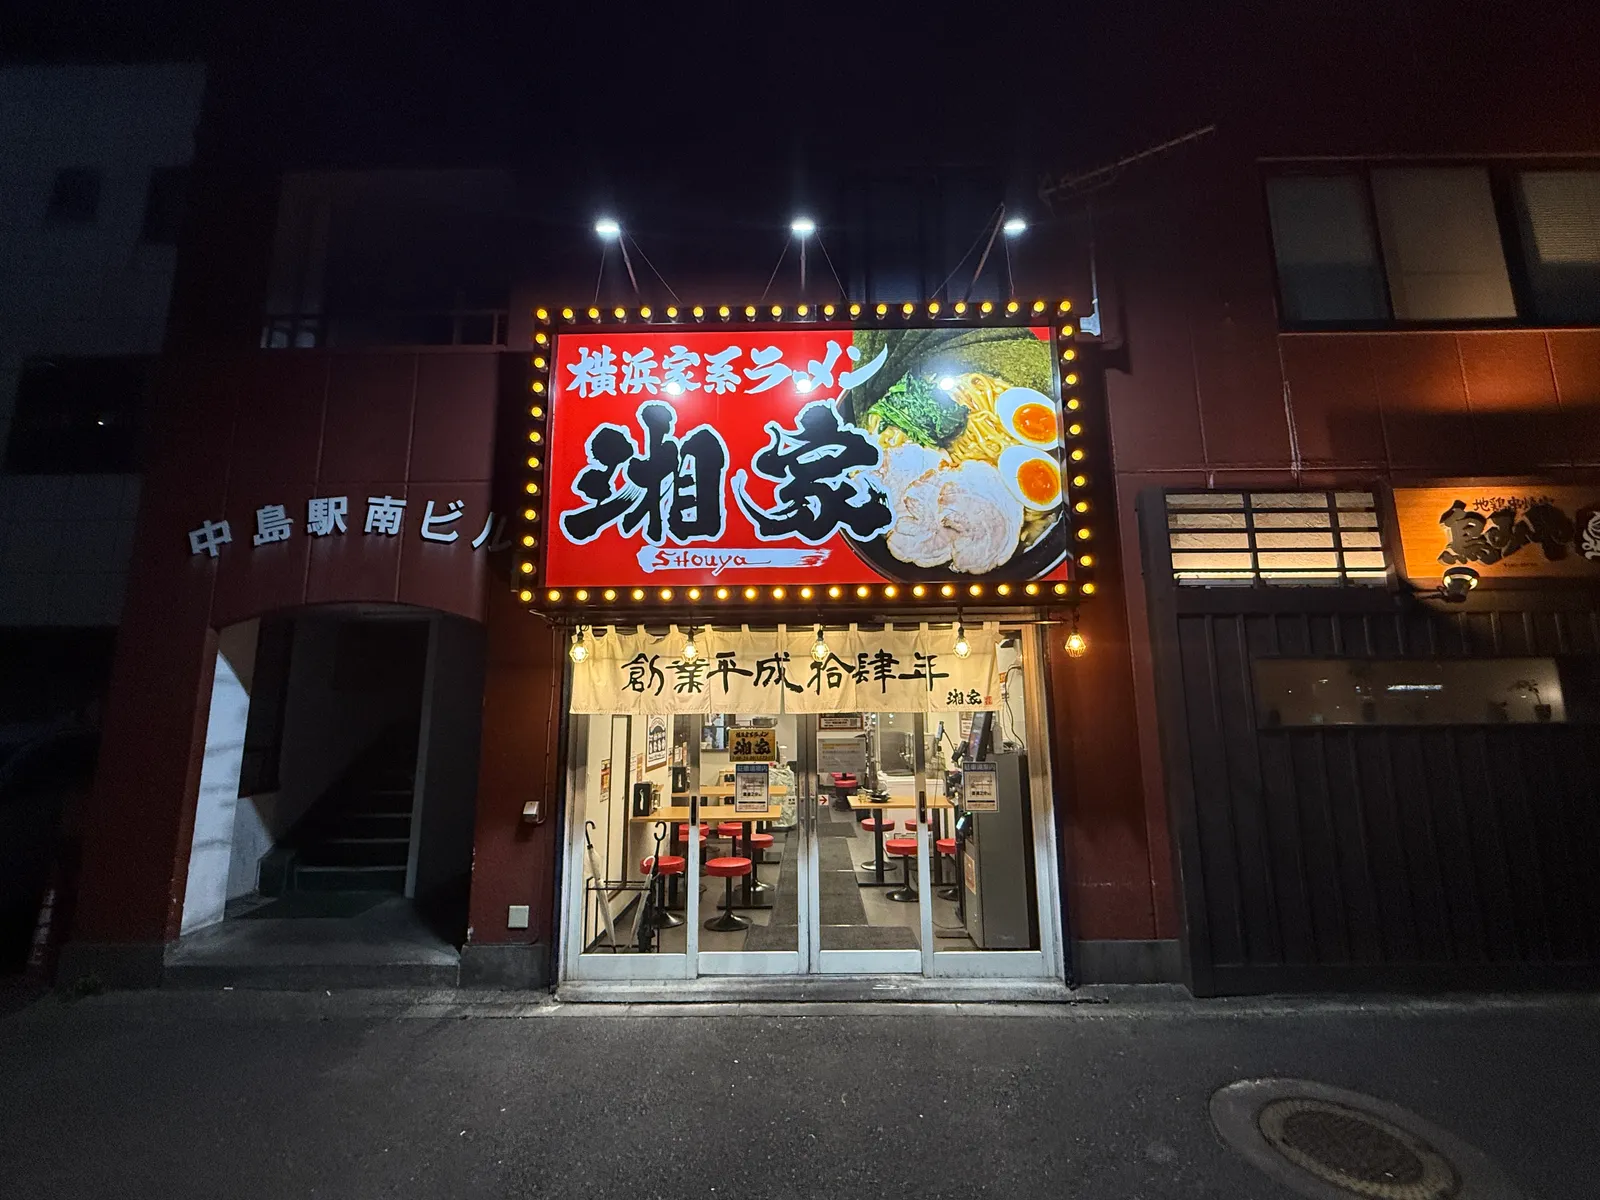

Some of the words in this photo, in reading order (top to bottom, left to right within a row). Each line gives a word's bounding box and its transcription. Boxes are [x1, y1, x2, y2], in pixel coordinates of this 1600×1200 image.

[566, 340, 888, 398] 横浜家系ラーメン
[559, 399, 894, 546] 湘家
[188, 495, 513, 557] 中島駅南ビル
[621, 648, 950, 696] 創業平成拾肆年
[946, 688, 982, 706] 湘家
